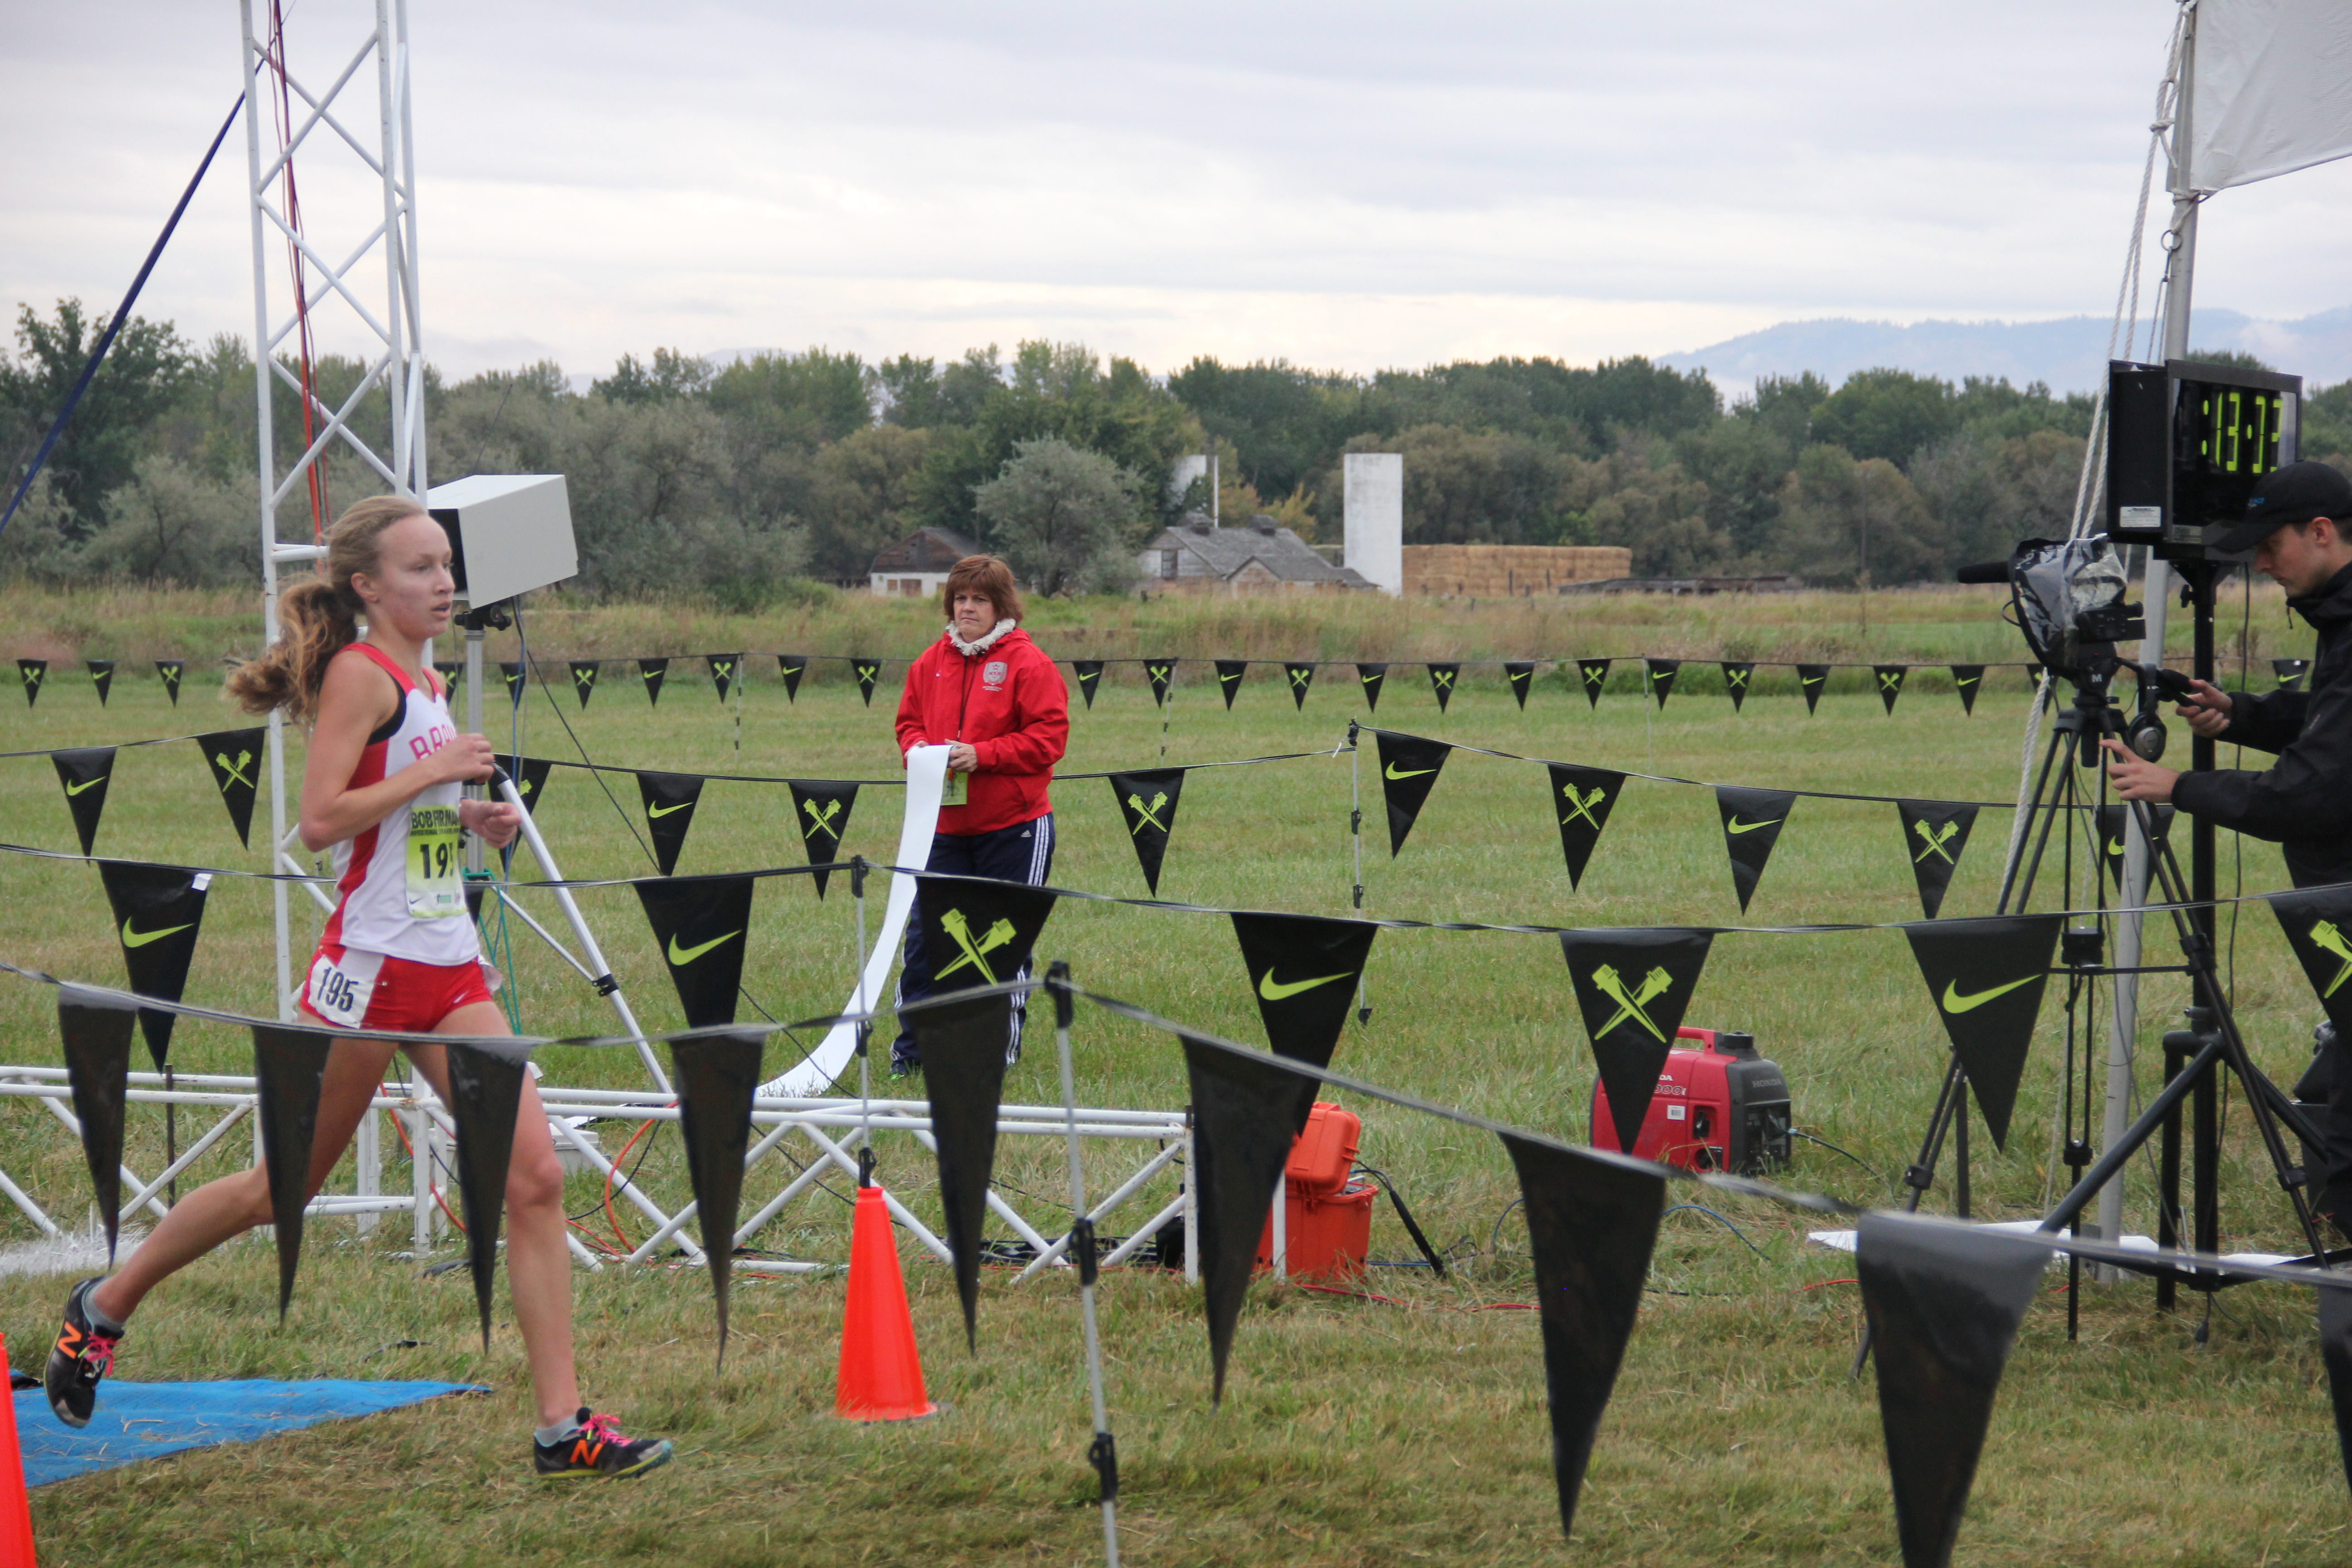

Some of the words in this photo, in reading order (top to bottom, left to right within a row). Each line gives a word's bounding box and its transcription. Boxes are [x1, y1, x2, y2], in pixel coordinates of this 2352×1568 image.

[411, 811, 433, 829] BOB
[317, 967, 359, 1012] 195
[1752, 1079, 1782, 1088] HONDA
[569, 1439, 604, 1466] N
